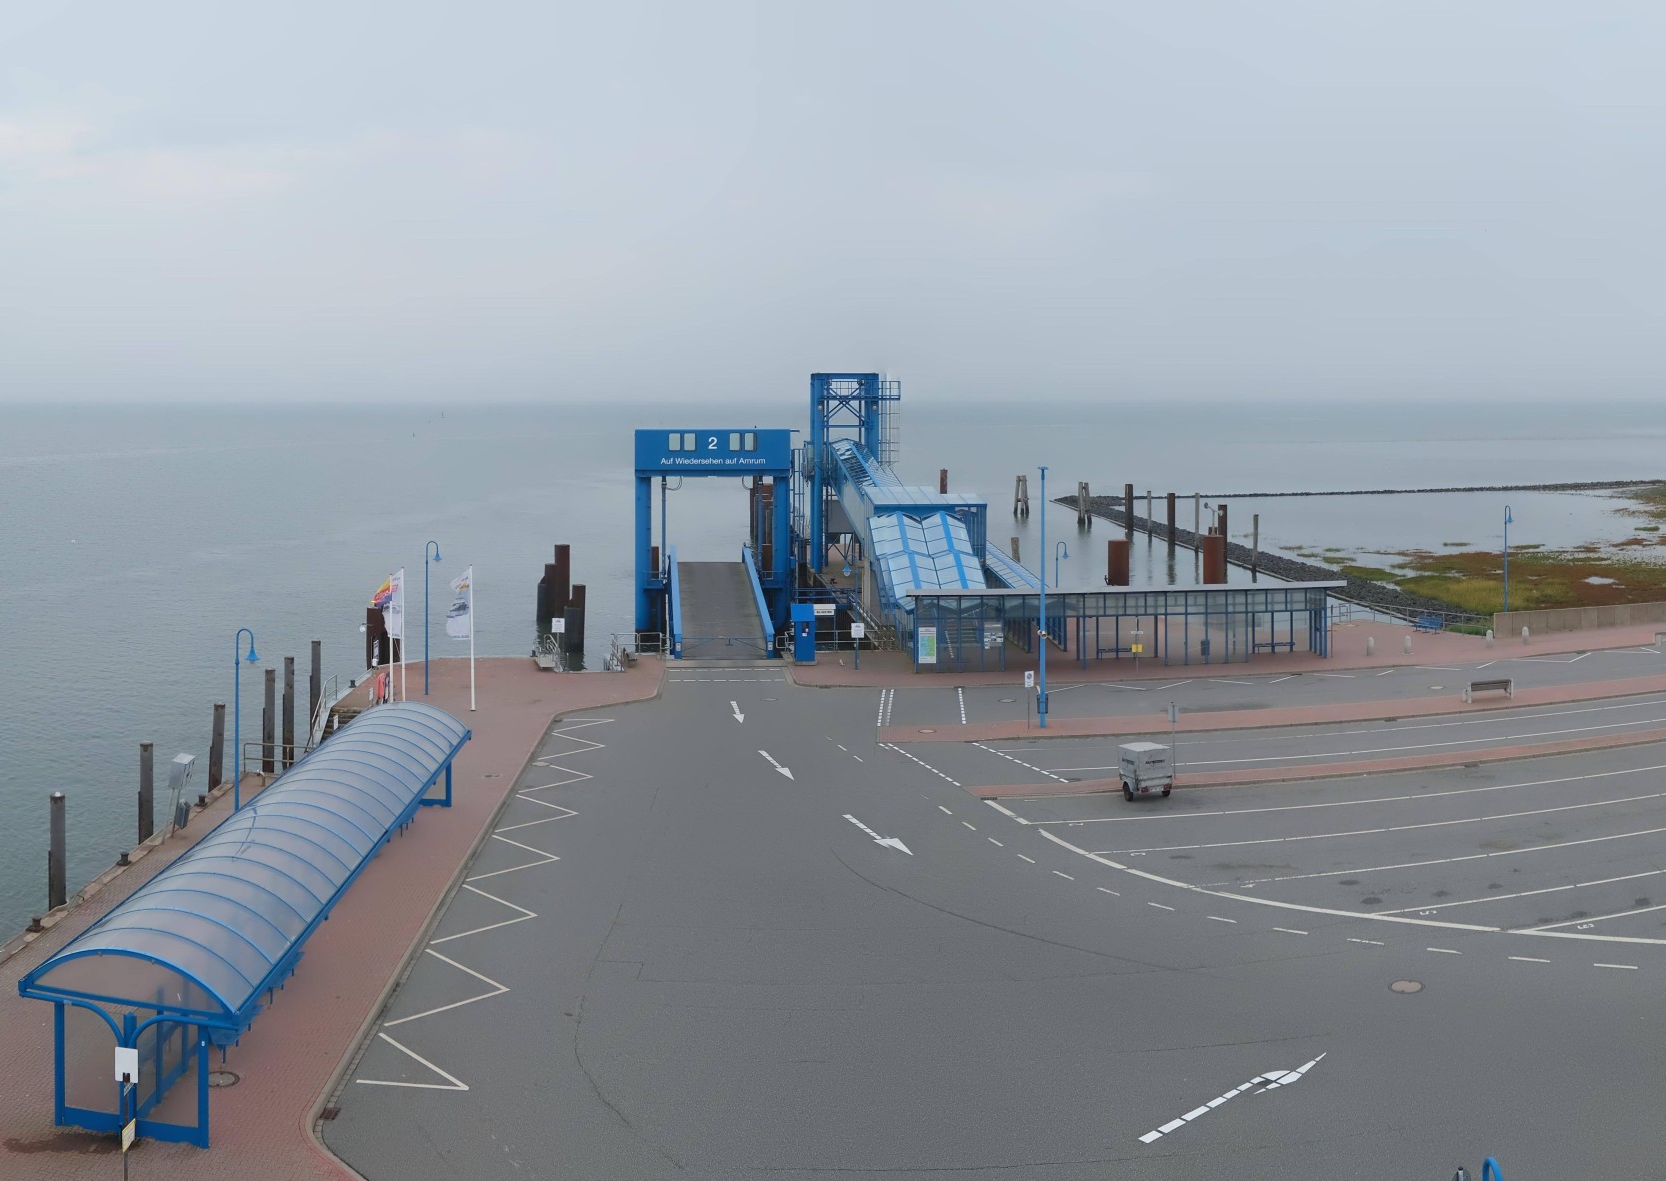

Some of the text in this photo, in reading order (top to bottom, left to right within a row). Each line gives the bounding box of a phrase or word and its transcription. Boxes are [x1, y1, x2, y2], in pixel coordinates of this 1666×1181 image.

[708, 437, 717, 450] 2
[660, 457, 673, 465] Auf
[675, 457, 723, 465] Wiedersehen
[725, 457, 737, 465] auf
